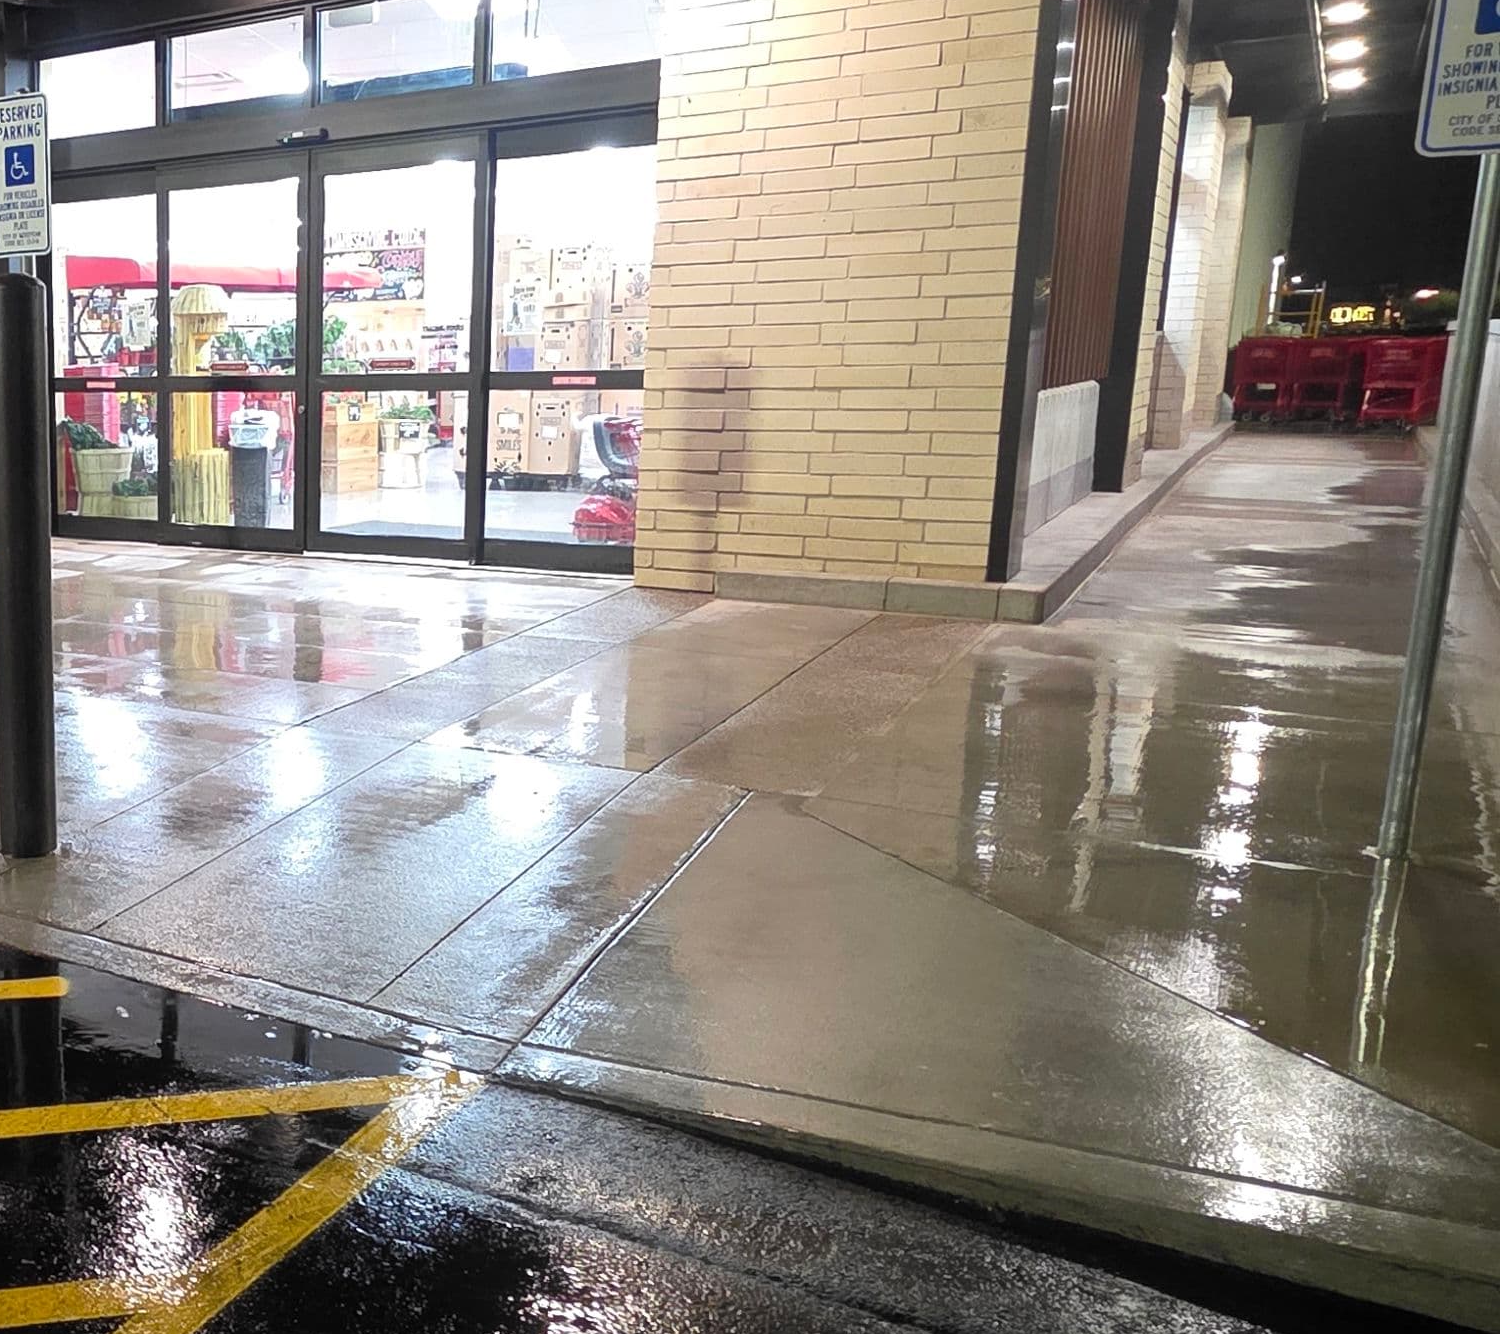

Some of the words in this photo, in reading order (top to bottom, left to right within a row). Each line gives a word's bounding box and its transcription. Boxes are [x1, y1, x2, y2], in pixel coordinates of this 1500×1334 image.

[1466, 42, 1493, 59] FOR
[1443, 60, 1500, 79] SHOWIN
[1438, 77, 1498, 97] INSIGNIA
[1449, 115, 1474, 126] CITY
[1478, 113, 1494, 124] OF
